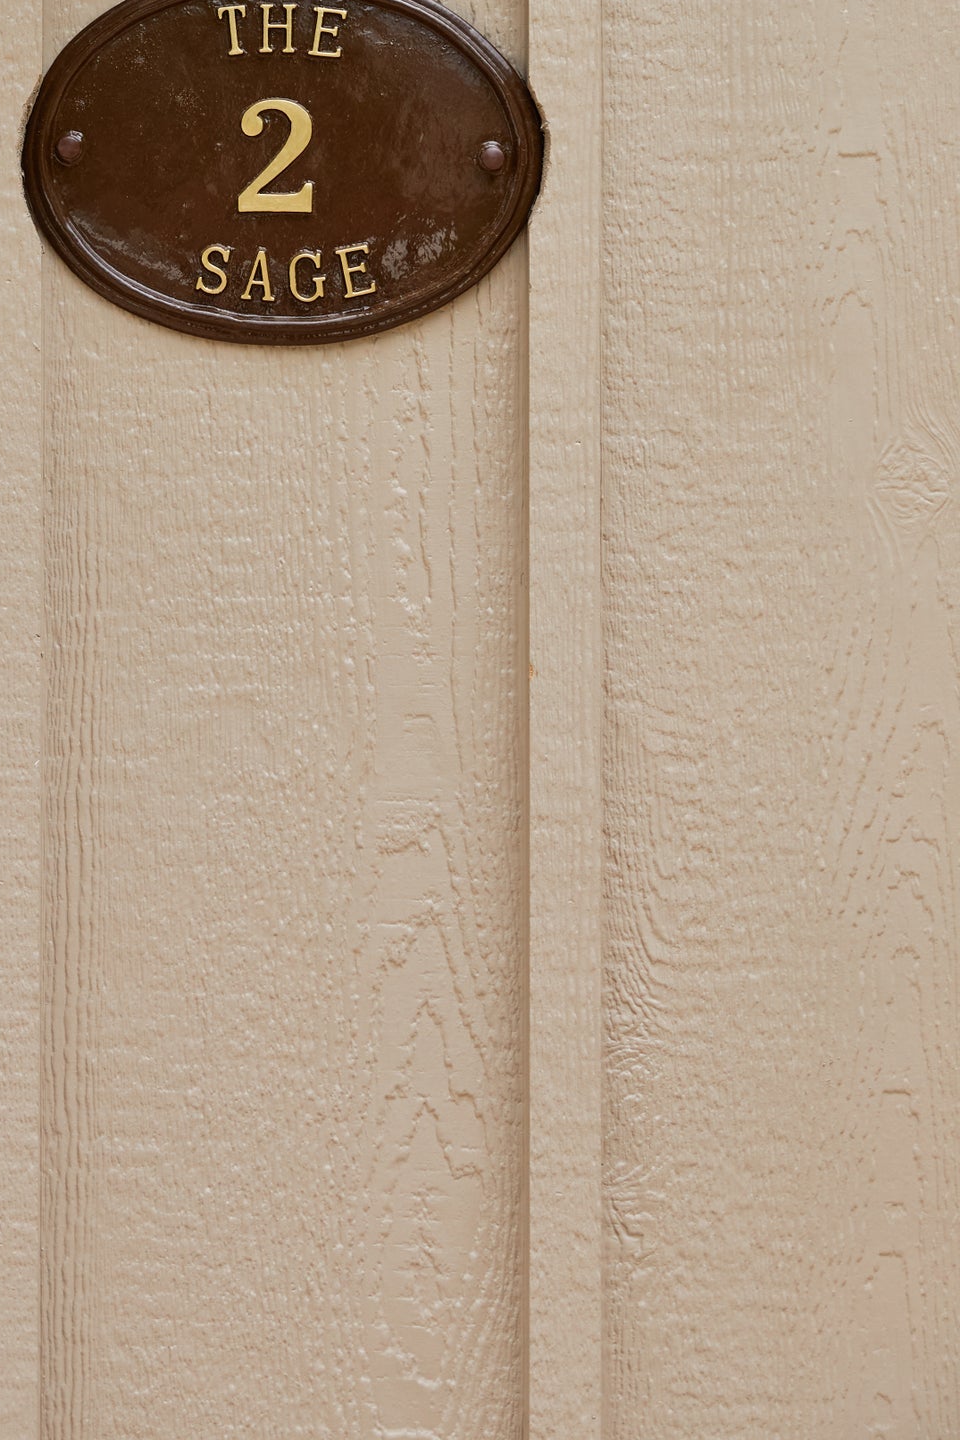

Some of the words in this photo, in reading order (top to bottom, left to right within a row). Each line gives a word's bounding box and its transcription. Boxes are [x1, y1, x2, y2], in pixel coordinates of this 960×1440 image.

[217, 3, 348, 58] THE
[237, 98, 314, 213] 2
[195, 242, 377, 303] SAGE
